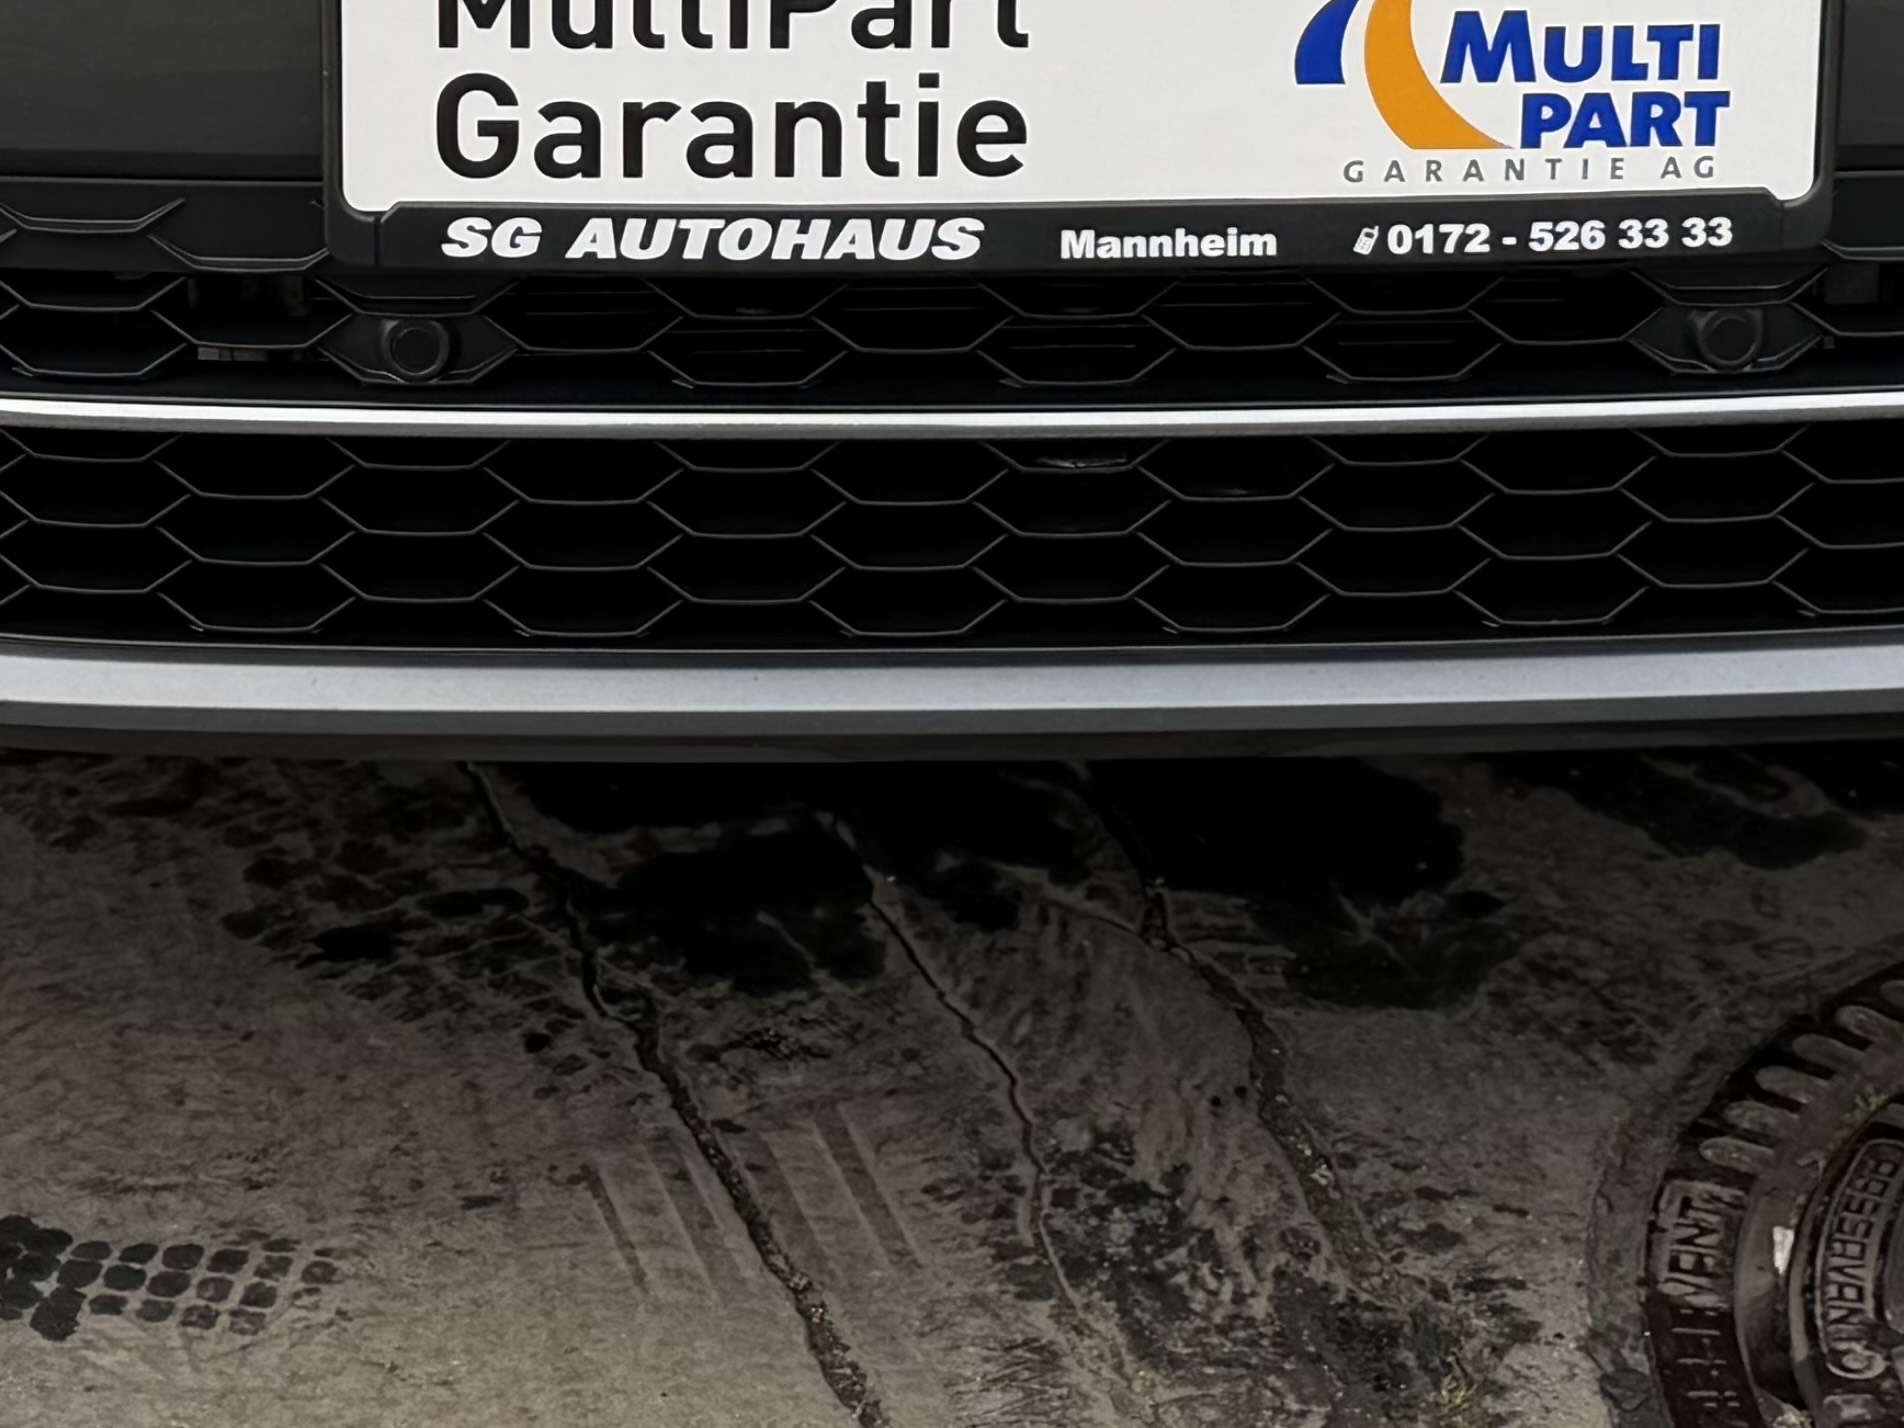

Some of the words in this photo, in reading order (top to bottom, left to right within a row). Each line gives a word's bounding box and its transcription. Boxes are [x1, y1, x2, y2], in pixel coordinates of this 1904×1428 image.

[1439, 9, 1722, 84] MULTI
[435, 72, 1027, 179] Garantie
[1519, 90, 1731, 149] PART
[1343, 157, 1625, 184] GARANTIE
[1660, 155, 1715, 179] AG
[441, 217, 543, 259] SG
[565, 218, 985, 261] AUTOHAUS
[1060, 226, 1278, 261] Mannheim
[1387, 223, 1491, 256] 0172
[1528, 220, 1606, 253] 526
[1618, 218, 1668, 250] 33
[1681, 216, 1733, 248] 33
